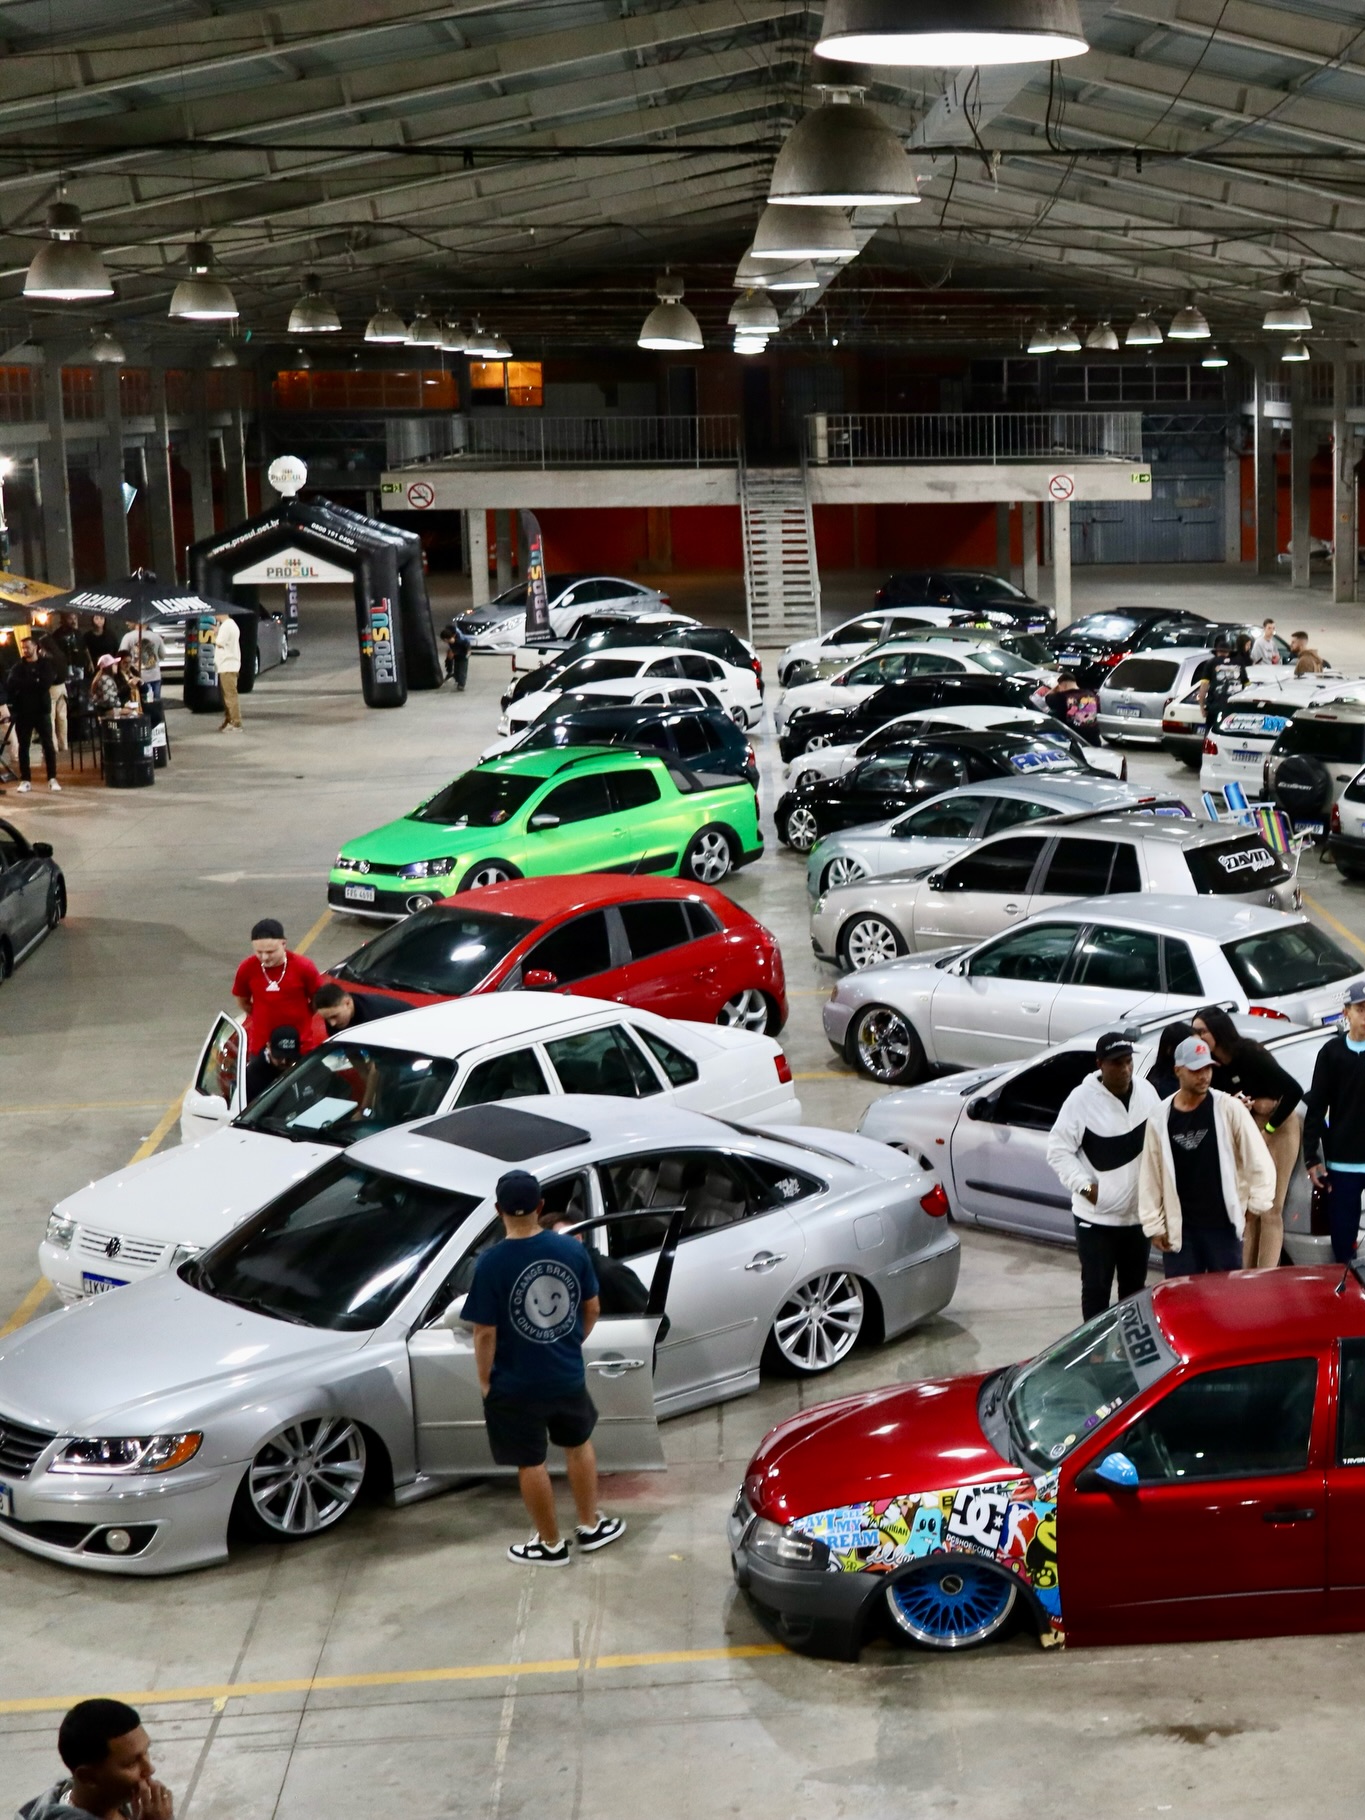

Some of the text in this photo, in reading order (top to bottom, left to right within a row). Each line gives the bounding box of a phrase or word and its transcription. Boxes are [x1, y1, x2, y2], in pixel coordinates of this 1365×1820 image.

[266, 566, 319, 577] PROSUL
[530, 534, 547, 625] PROSUL
[370, 597, 395, 684] PROSUL
[513, 1264, 575, 1306] ORANGE BRAND
[815, 1530, 879, 1550] REAM
[836, 1519, 862, 1533] MY
